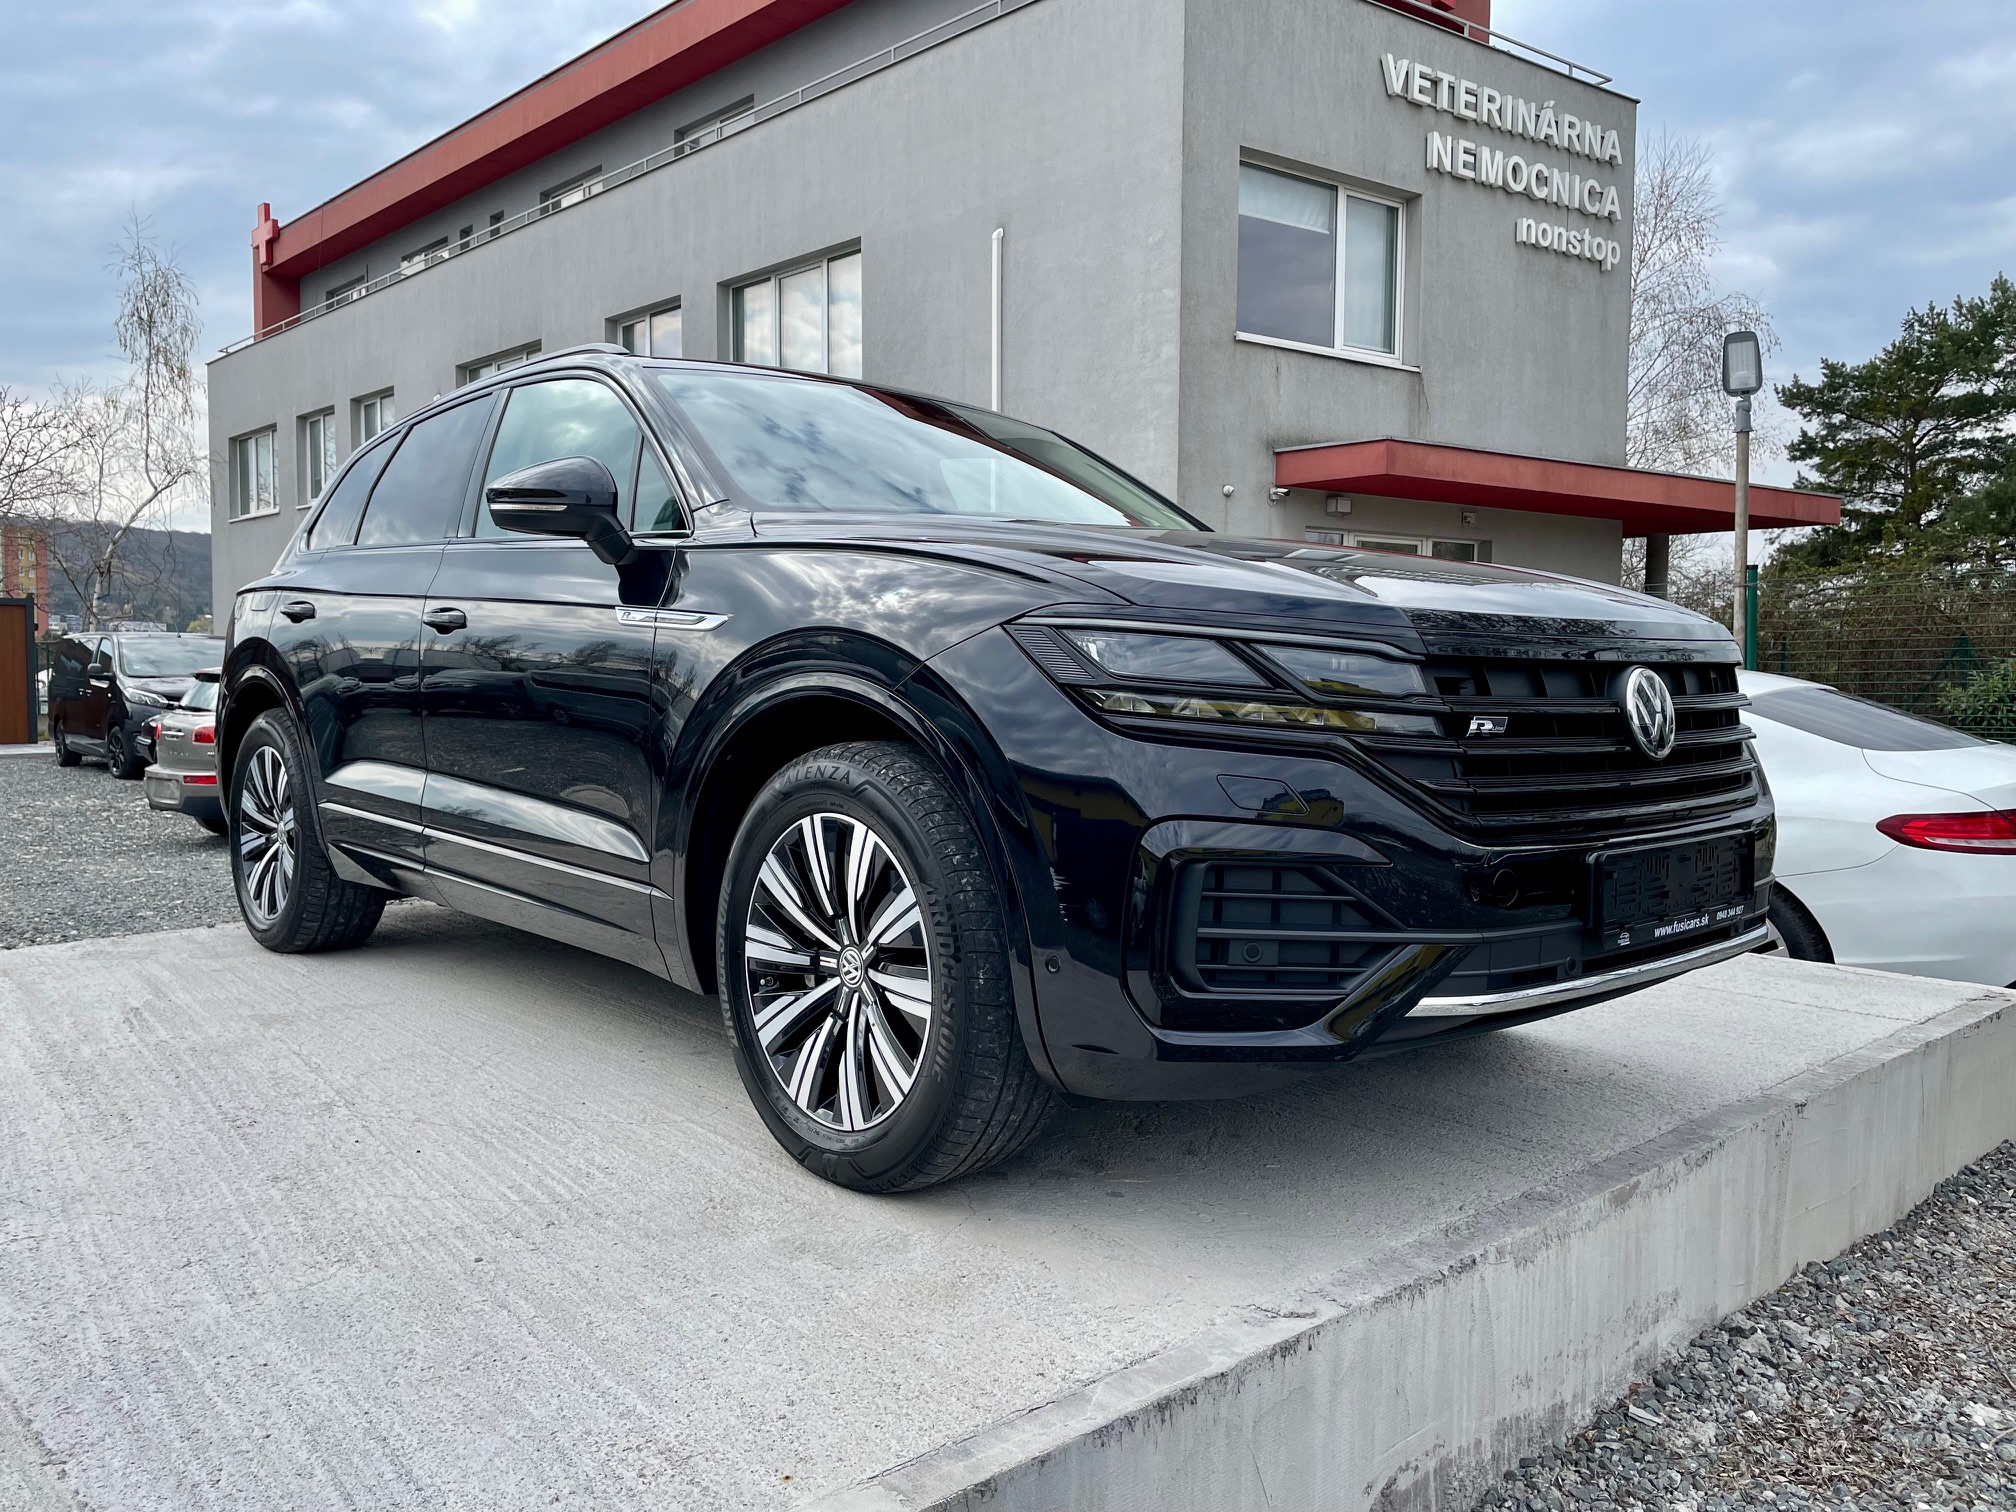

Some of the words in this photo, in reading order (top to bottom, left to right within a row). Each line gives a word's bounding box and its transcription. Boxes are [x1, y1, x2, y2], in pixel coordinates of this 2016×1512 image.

[1381, 53, 1622, 167] VETERINÁRNA
[1426, 131, 1622, 222] NEMOCNICA
[1516, 217, 1621, 271] nonstop
[783, 764, 851, 788] ALENZA
[1654, 913, 1710, 938] www.fusicars.sk
[920, 877, 958, 1084] BRIDGESTONE
